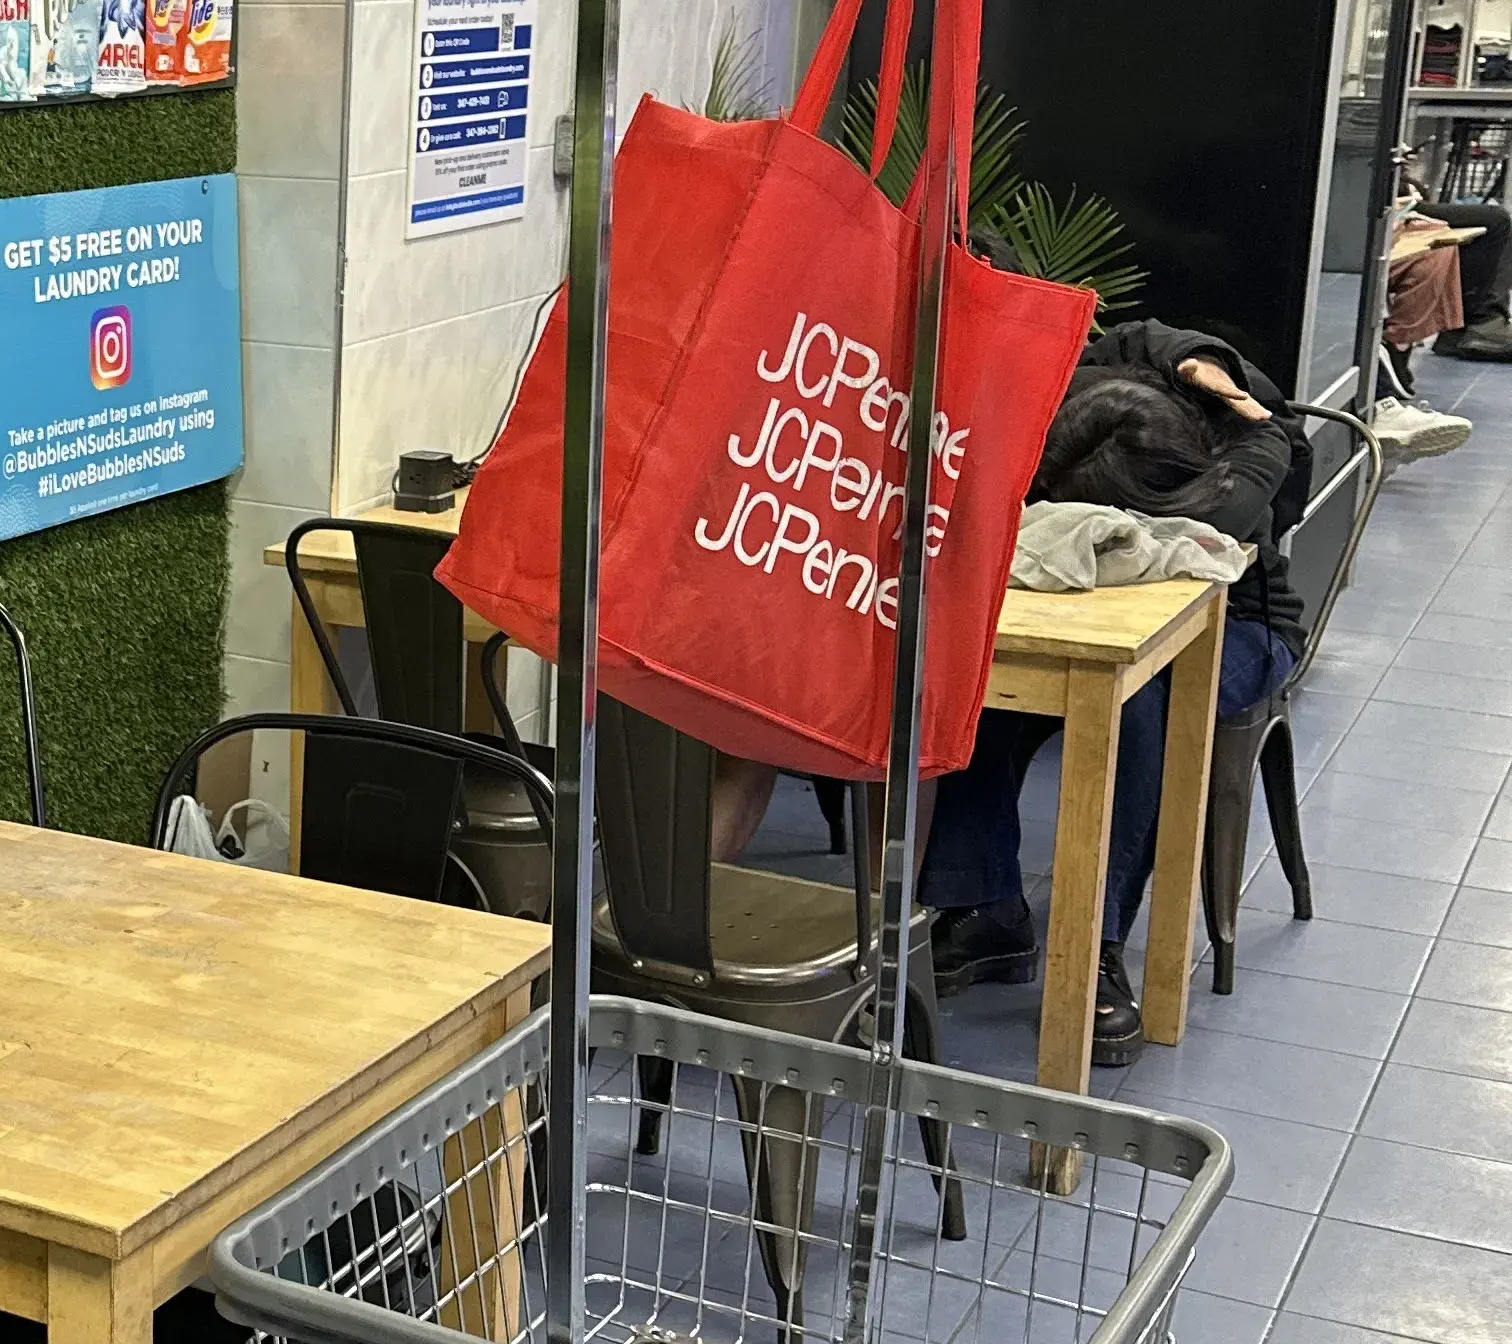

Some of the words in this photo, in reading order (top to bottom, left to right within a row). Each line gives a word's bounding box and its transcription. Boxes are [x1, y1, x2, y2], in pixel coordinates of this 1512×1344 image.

[98, 43, 143, 68] ARIEL
[4, 239, 44, 269] GET
[48, 236, 72, 266] $5
[76, 229, 123, 260] FREE
[126, 225, 153, 253] ON
[155, 218, 203, 248] YOUR
[34, 264, 123, 303] LAUNDRY
[126, 256, 180, 288] CARD!
[3, 416, 176, 481] @BubblesNSudsLaundry
[179, 408, 215, 433] using
[8, 427, 35, 447] Take
[37, 427, 45, 440] a
[47, 416, 85, 440] picture
[87, 408, 108, 429] and
[109, 407, 128, 424] tag
[129, 404, 142, 418] us
[143, 401, 157, 415] on
[159, 388, 208, 411] Instagram
[38, 440, 186, 498] #iLoveBubblesNSuds
